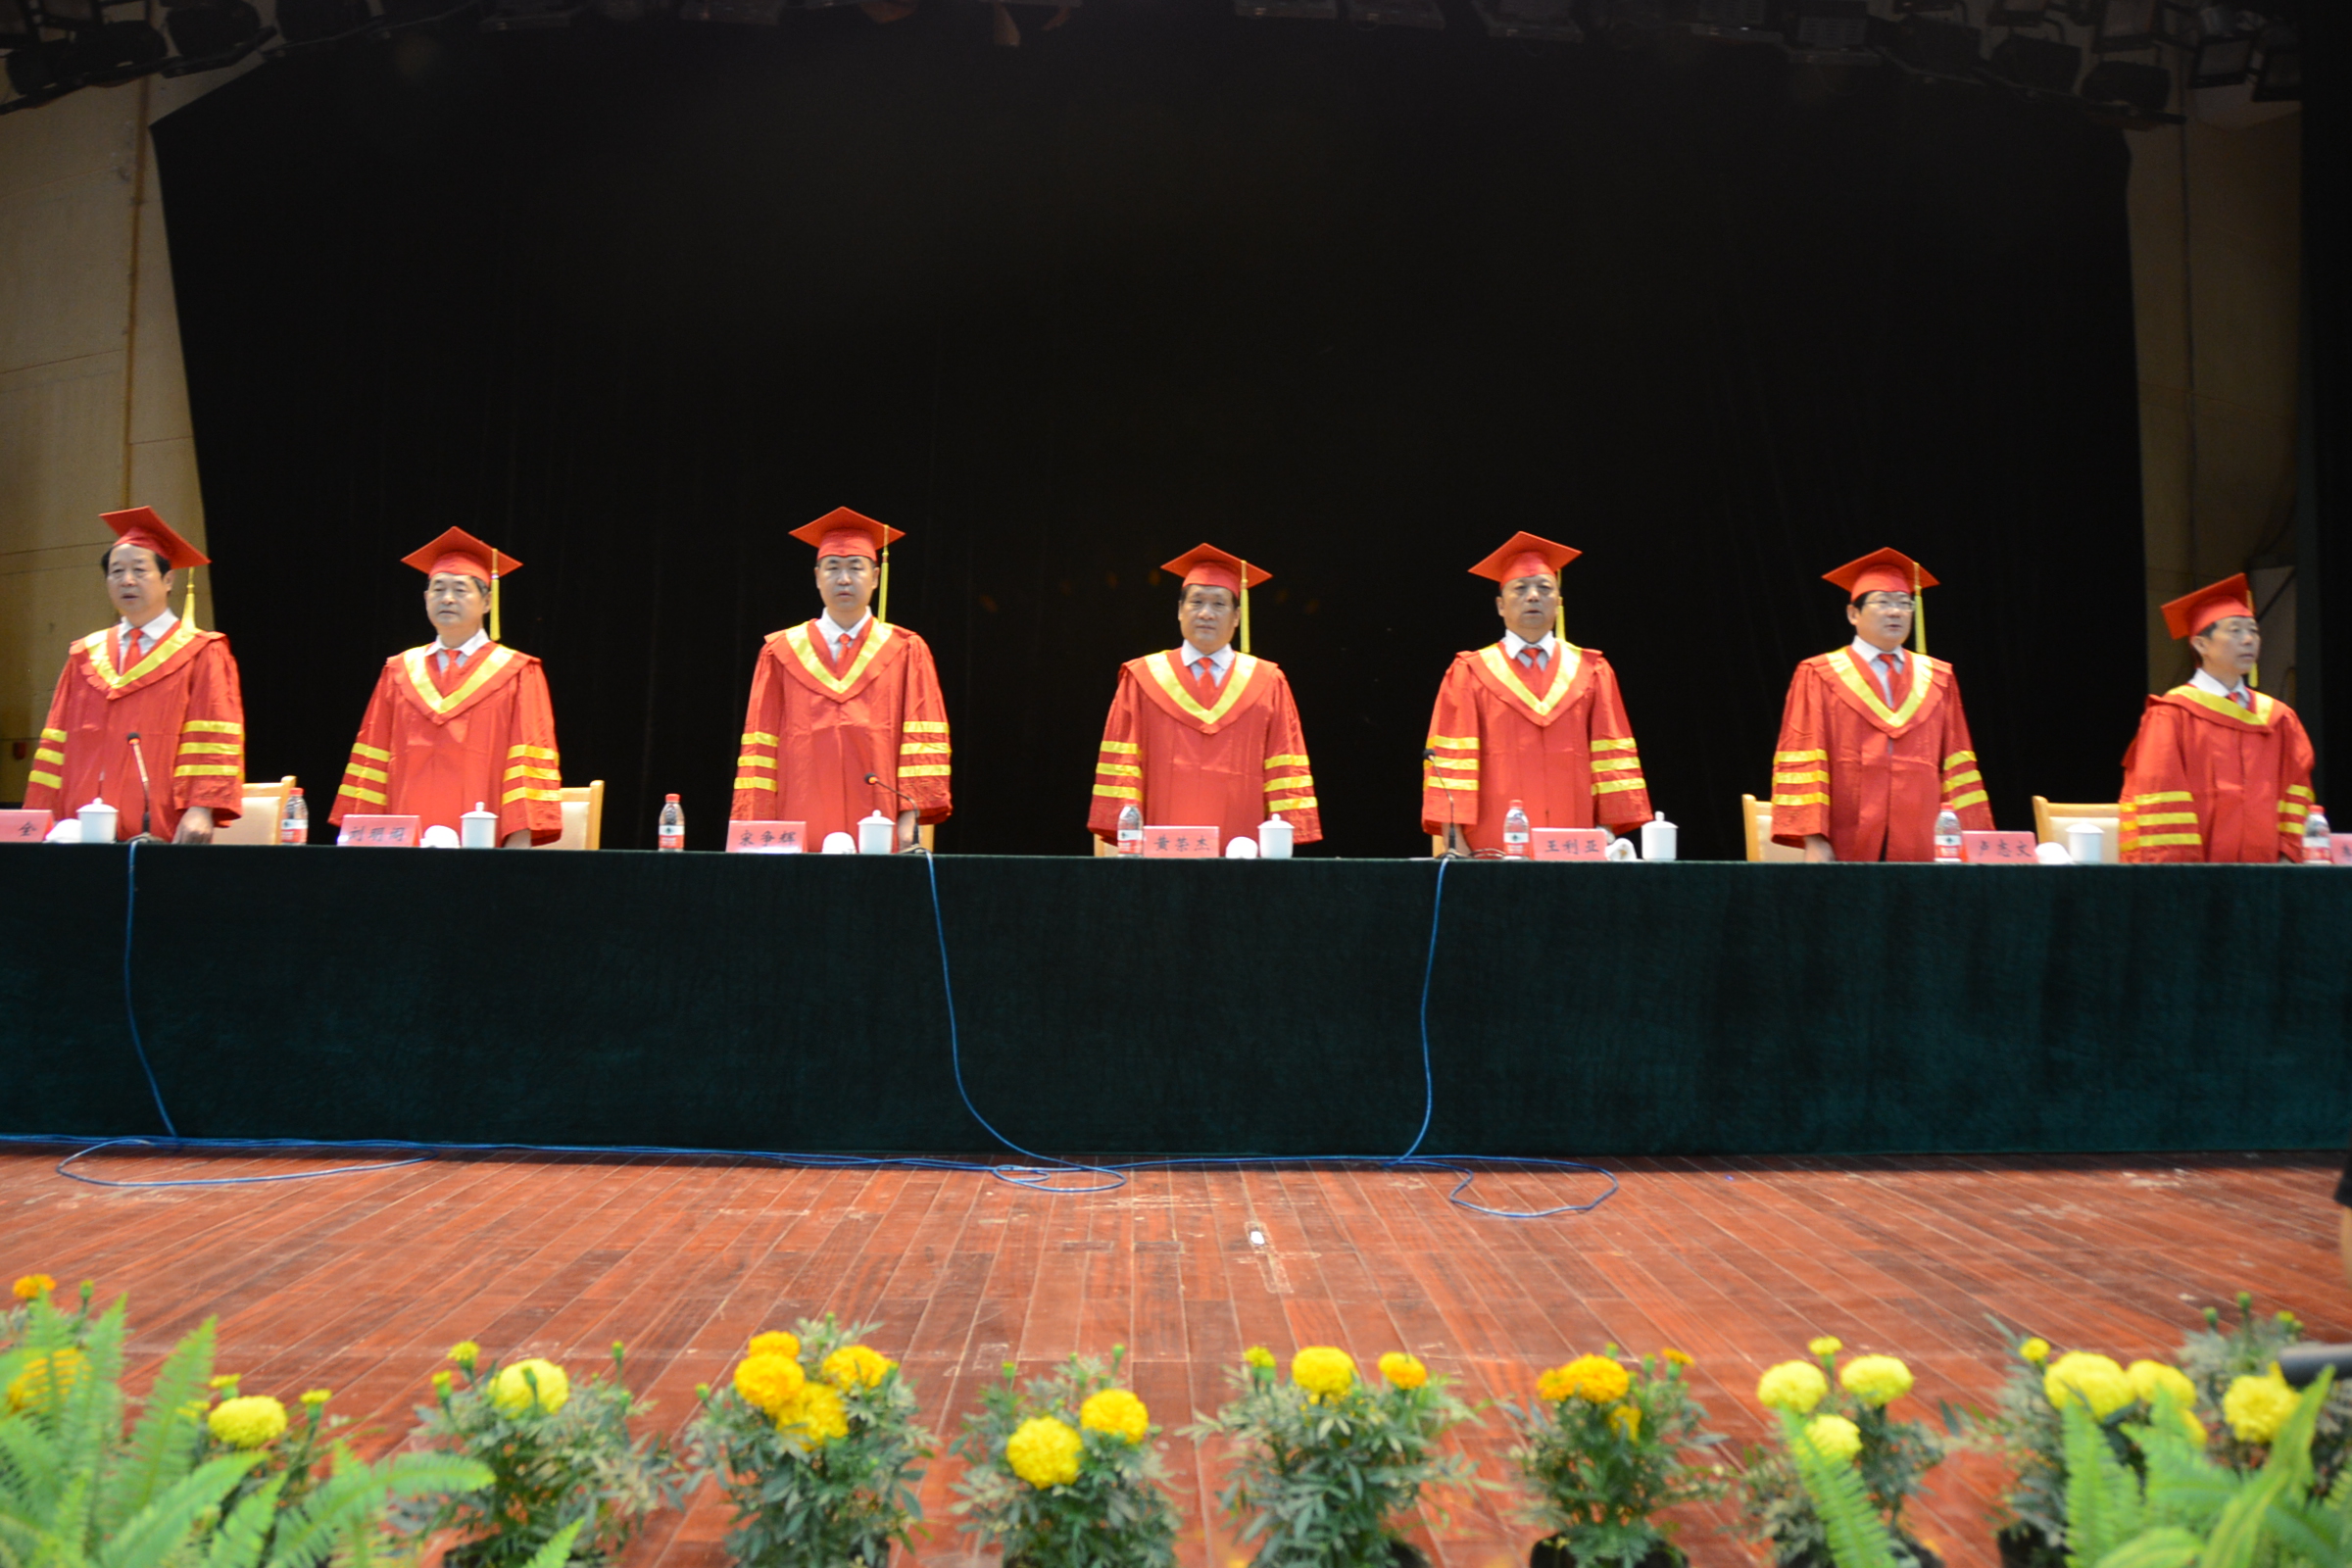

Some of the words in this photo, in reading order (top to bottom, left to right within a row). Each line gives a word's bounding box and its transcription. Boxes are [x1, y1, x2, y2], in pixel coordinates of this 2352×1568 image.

[1154, 834, 1210, 853] 黄荣杰
[1545, 839, 1599, 855] 王利亚
